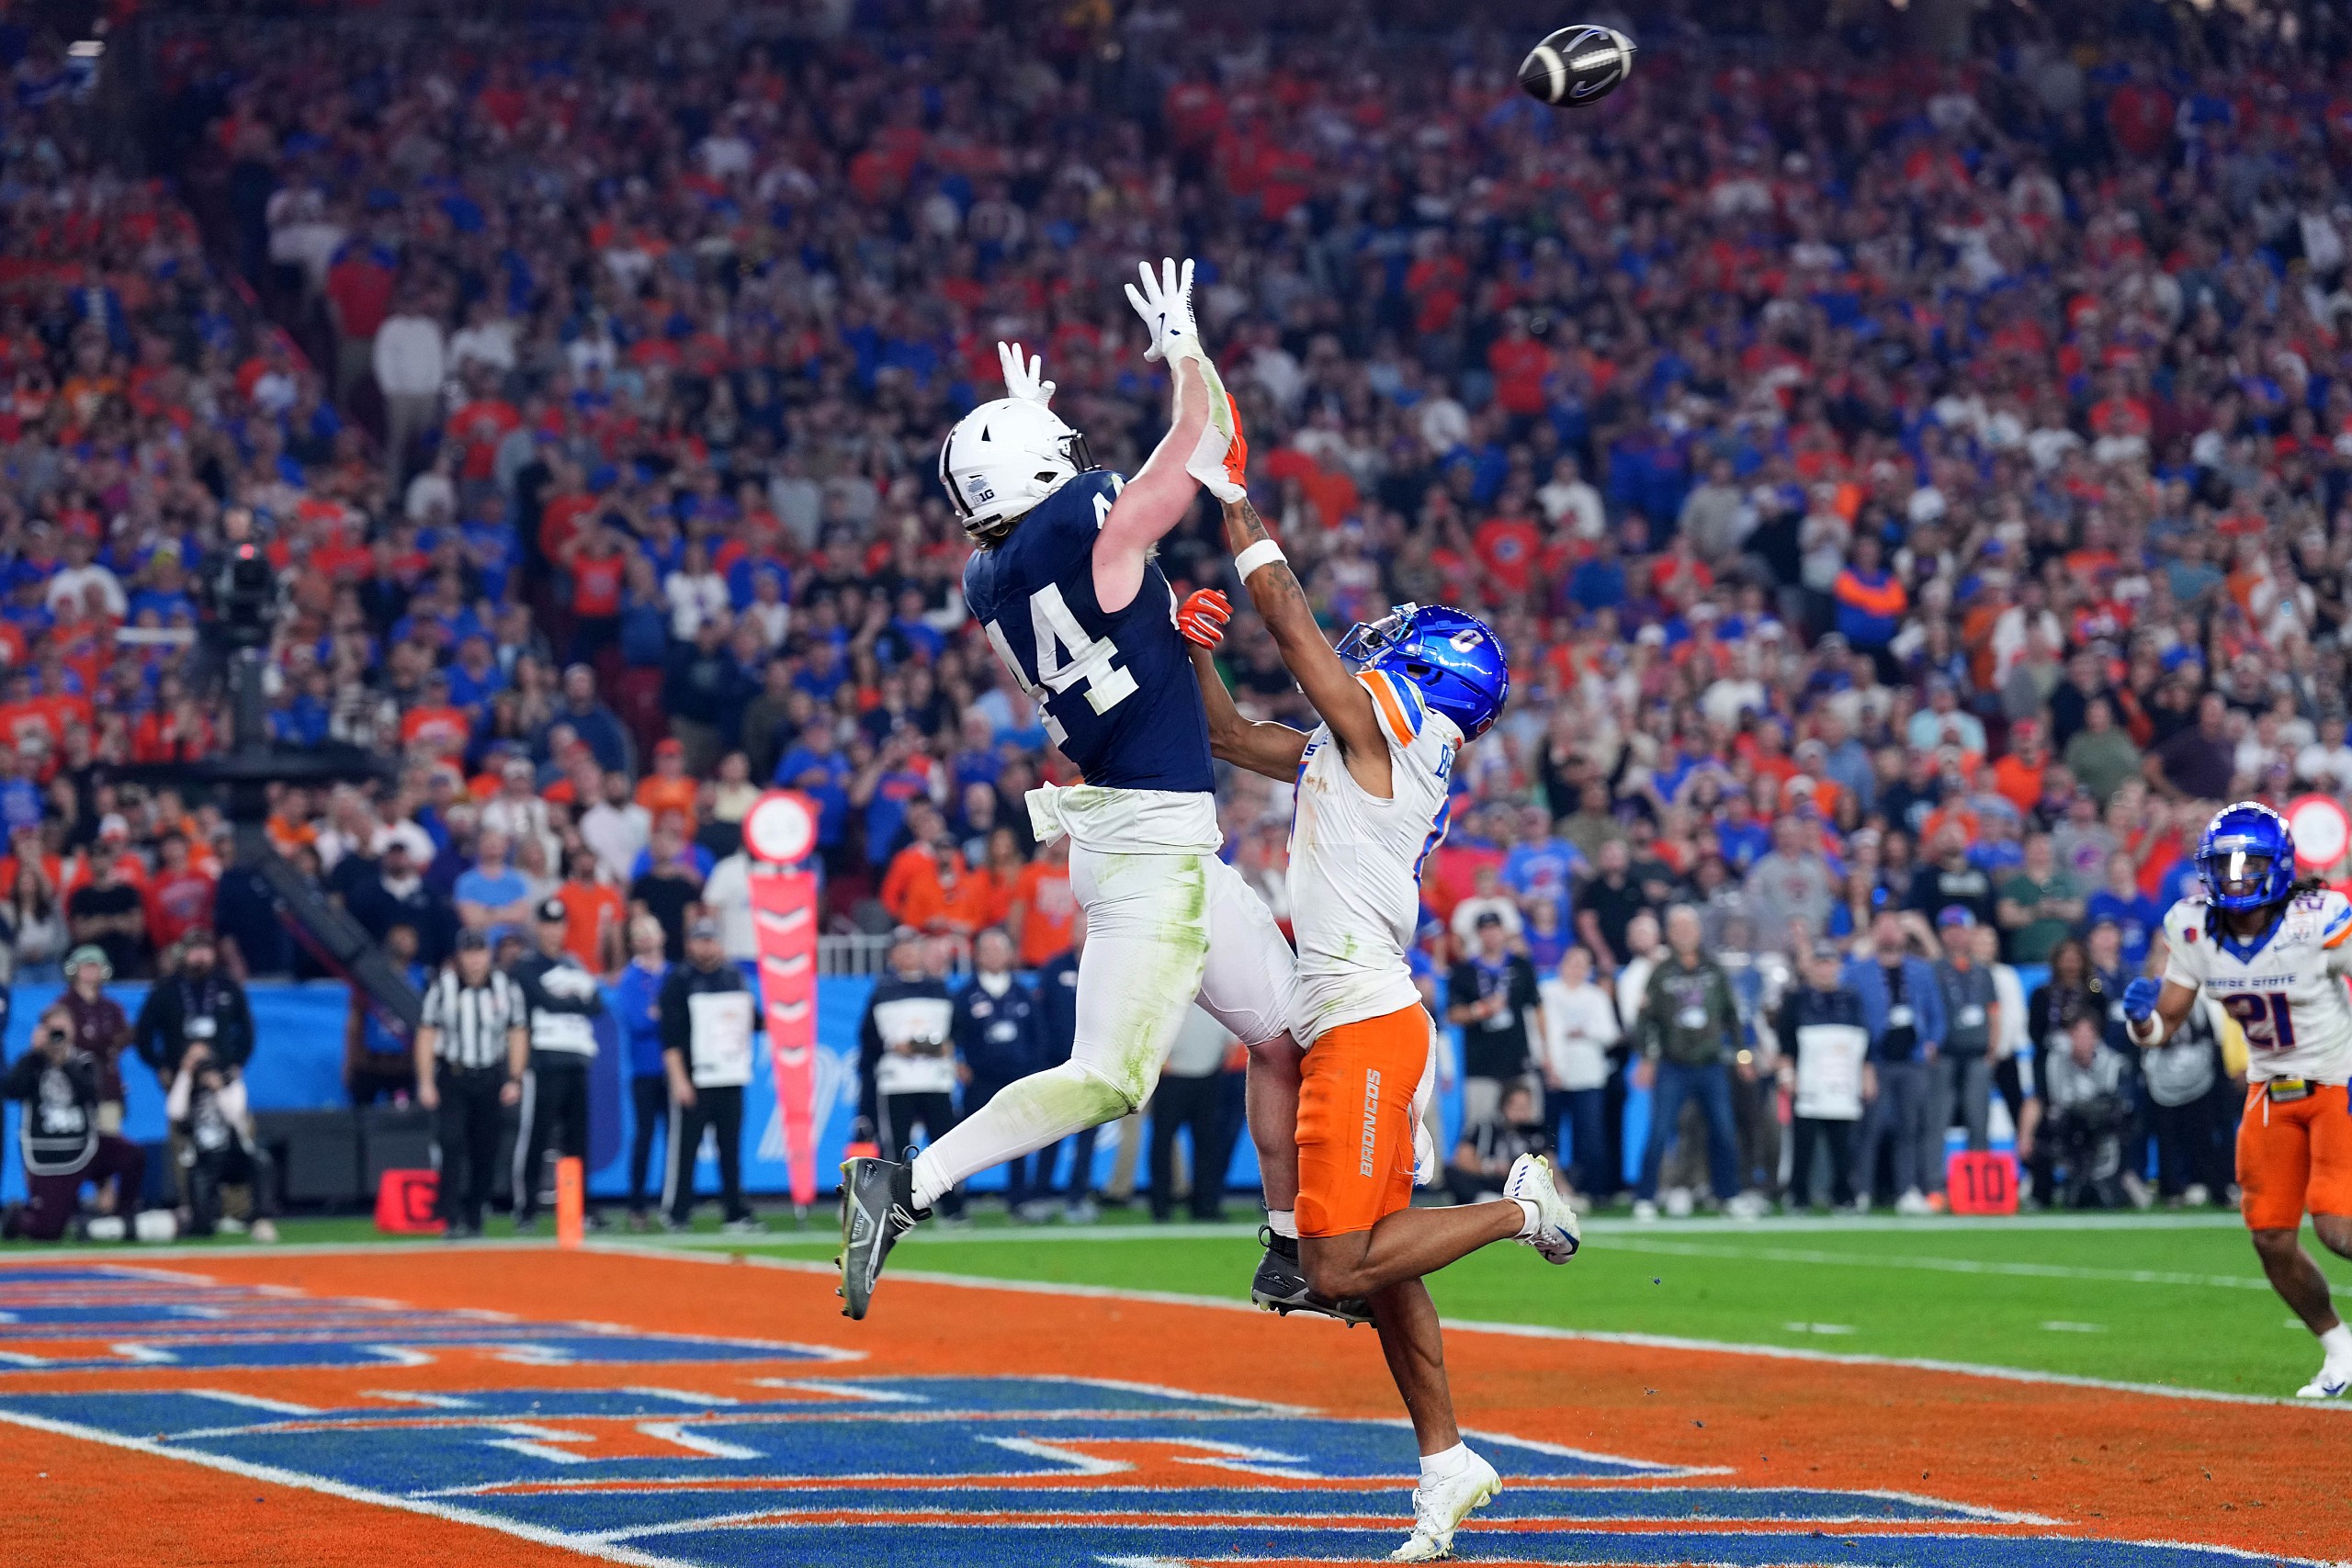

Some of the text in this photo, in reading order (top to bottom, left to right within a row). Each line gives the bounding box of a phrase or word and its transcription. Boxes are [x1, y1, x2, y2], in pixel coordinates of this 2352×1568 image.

[2222, 990, 2296, 1051] 21
[1360, 1067, 1381, 1179] BRONCOS
[1964, 1162, 2005, 1202] 10
